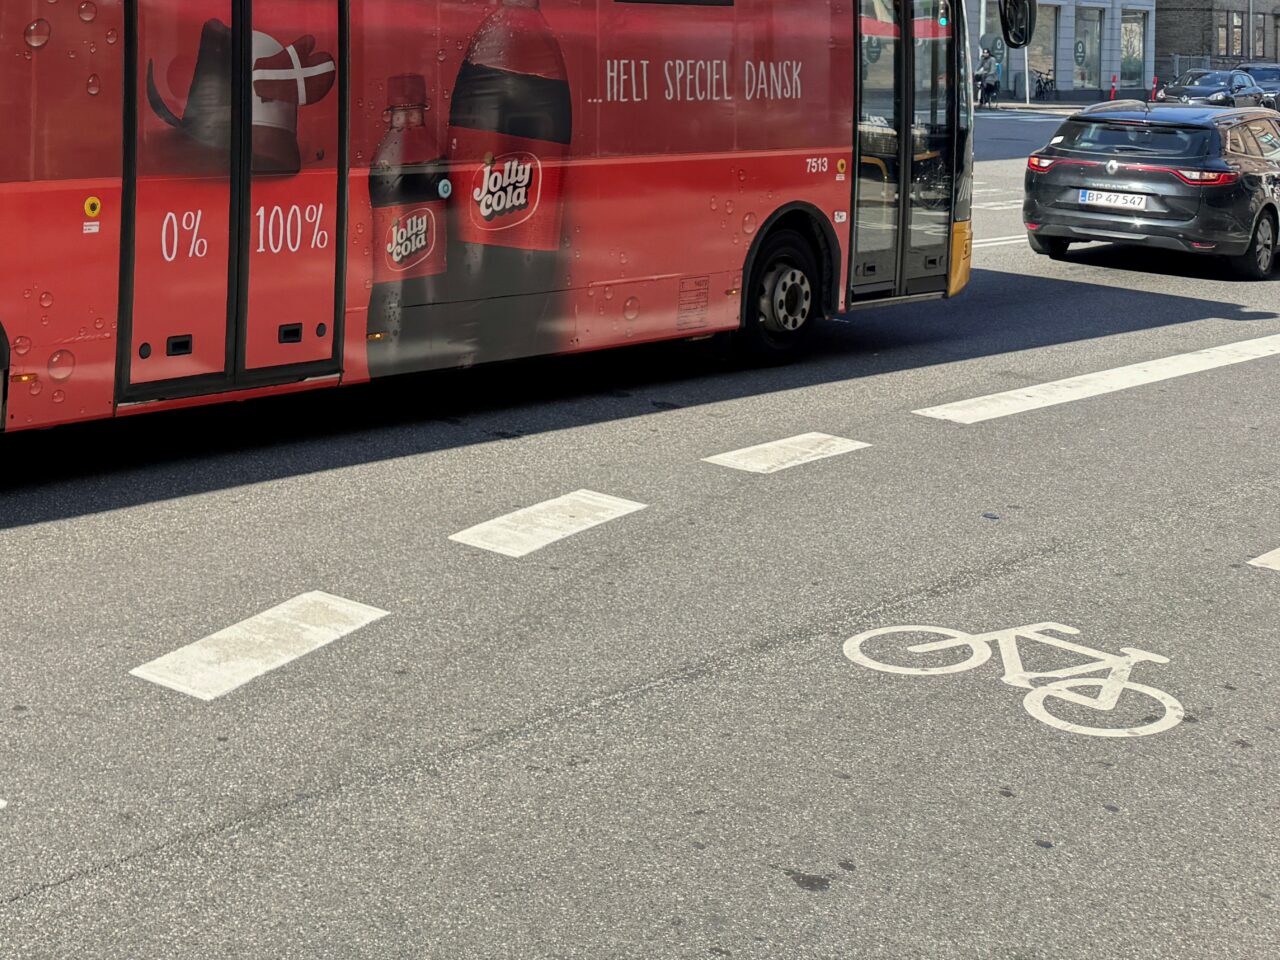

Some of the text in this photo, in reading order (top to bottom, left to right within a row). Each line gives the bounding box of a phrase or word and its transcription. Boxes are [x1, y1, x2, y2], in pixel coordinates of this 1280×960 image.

[664, 59, 734, 101] SPECIEL
[745, 60, 802, 100] DANSK
[806, 157, 828, 173] 7513
[1087, 192, 1144, 206] BP 47 547
[161, 209, 208, 262] 0%
[256, 203, 329, 253] 100%
